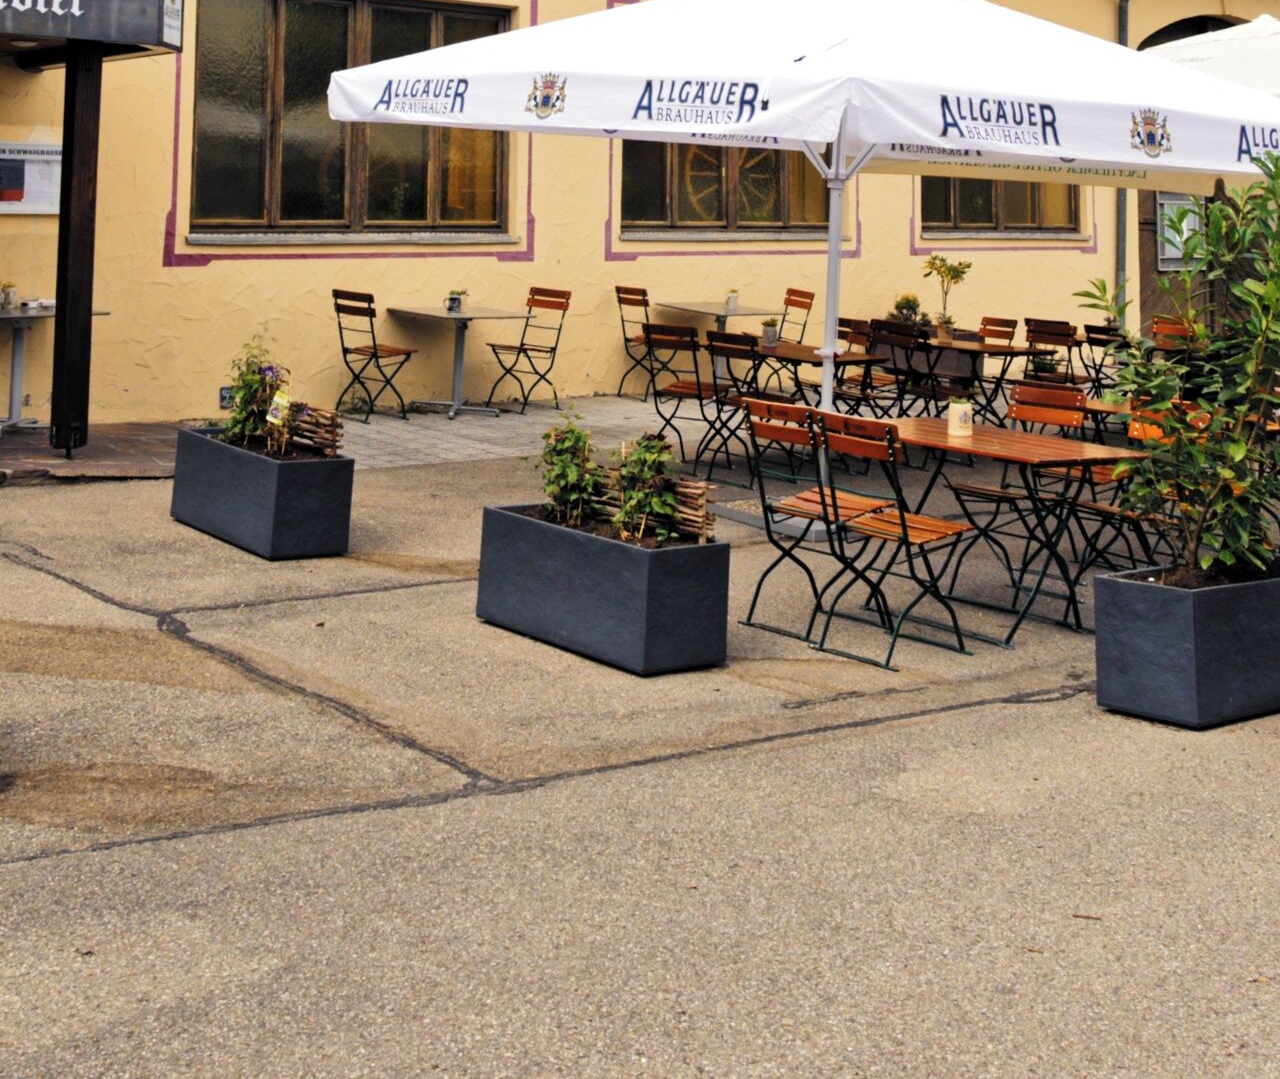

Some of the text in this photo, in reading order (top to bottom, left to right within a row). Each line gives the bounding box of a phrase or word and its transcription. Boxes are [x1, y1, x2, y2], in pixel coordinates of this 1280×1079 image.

[373, 78, 469, 114] ALLGÄUER
[392, 100, 449, 114] BRAUHAUS
[632, 79, 760, 124] ALLGÄUER
[656, 107, 734, 125] BRAUHAUS
[939, 94, 1061, 146] ALLGÄUER
[966, 125, 1040, 146] BRAUHAUS
